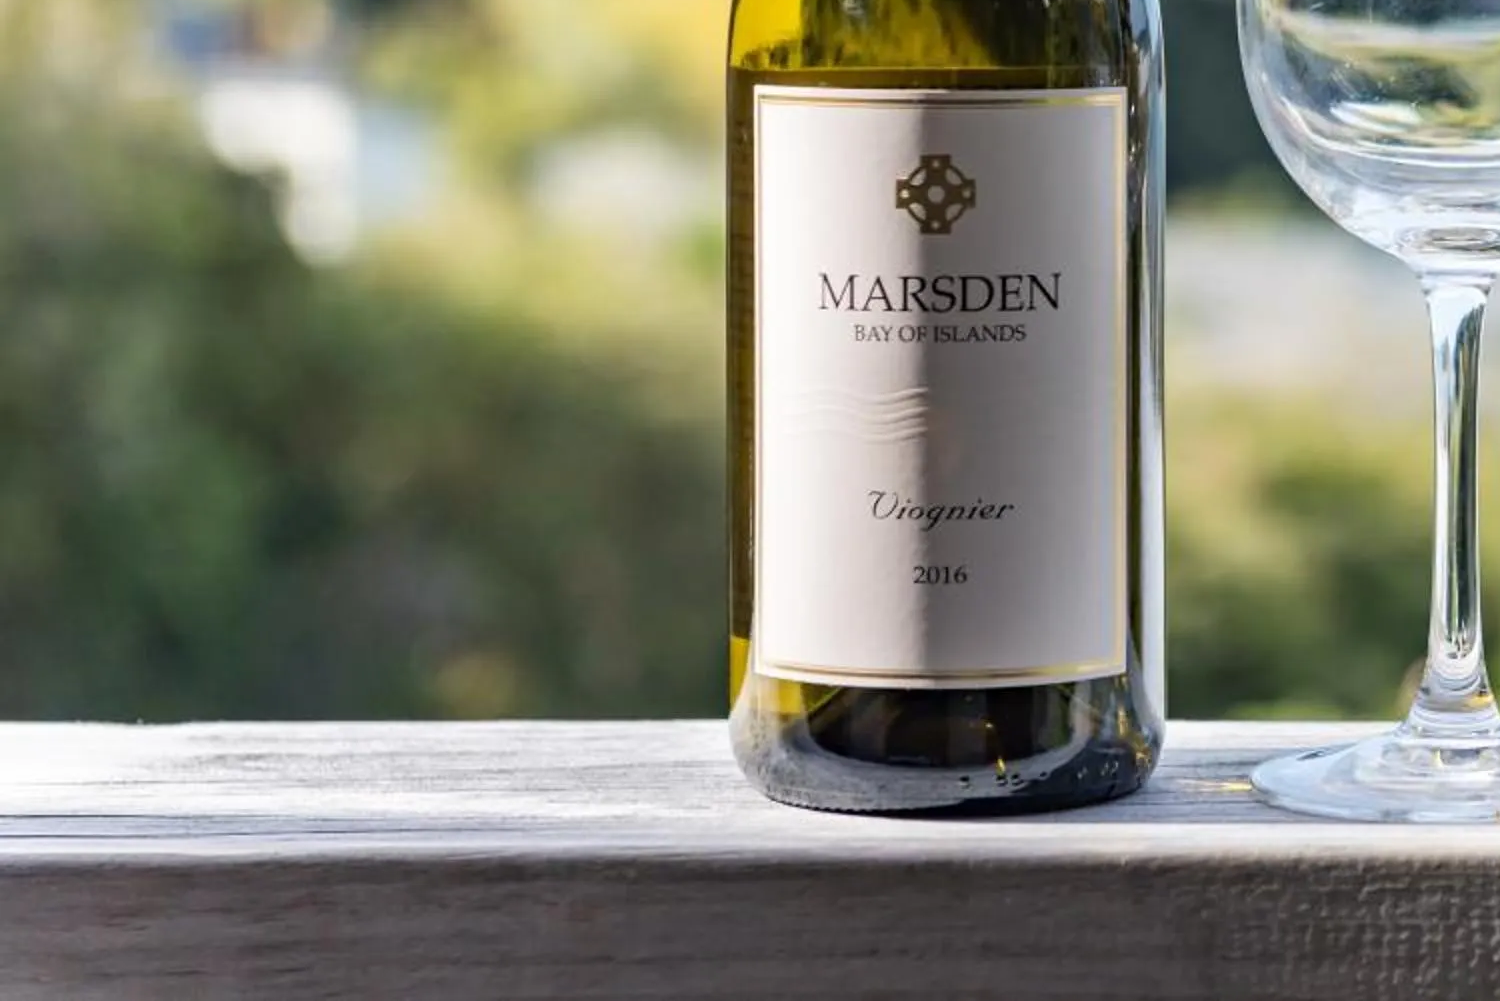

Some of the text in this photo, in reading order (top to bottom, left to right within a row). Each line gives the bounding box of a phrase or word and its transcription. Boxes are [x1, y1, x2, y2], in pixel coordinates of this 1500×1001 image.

[818, 272, 1062, 313] MARSDEN
[854, 323, 1028, 344] BAY OF ISLANDS
[868, 490, 1016, 532] Viognier
[913, 565, 968, 585] 2016
